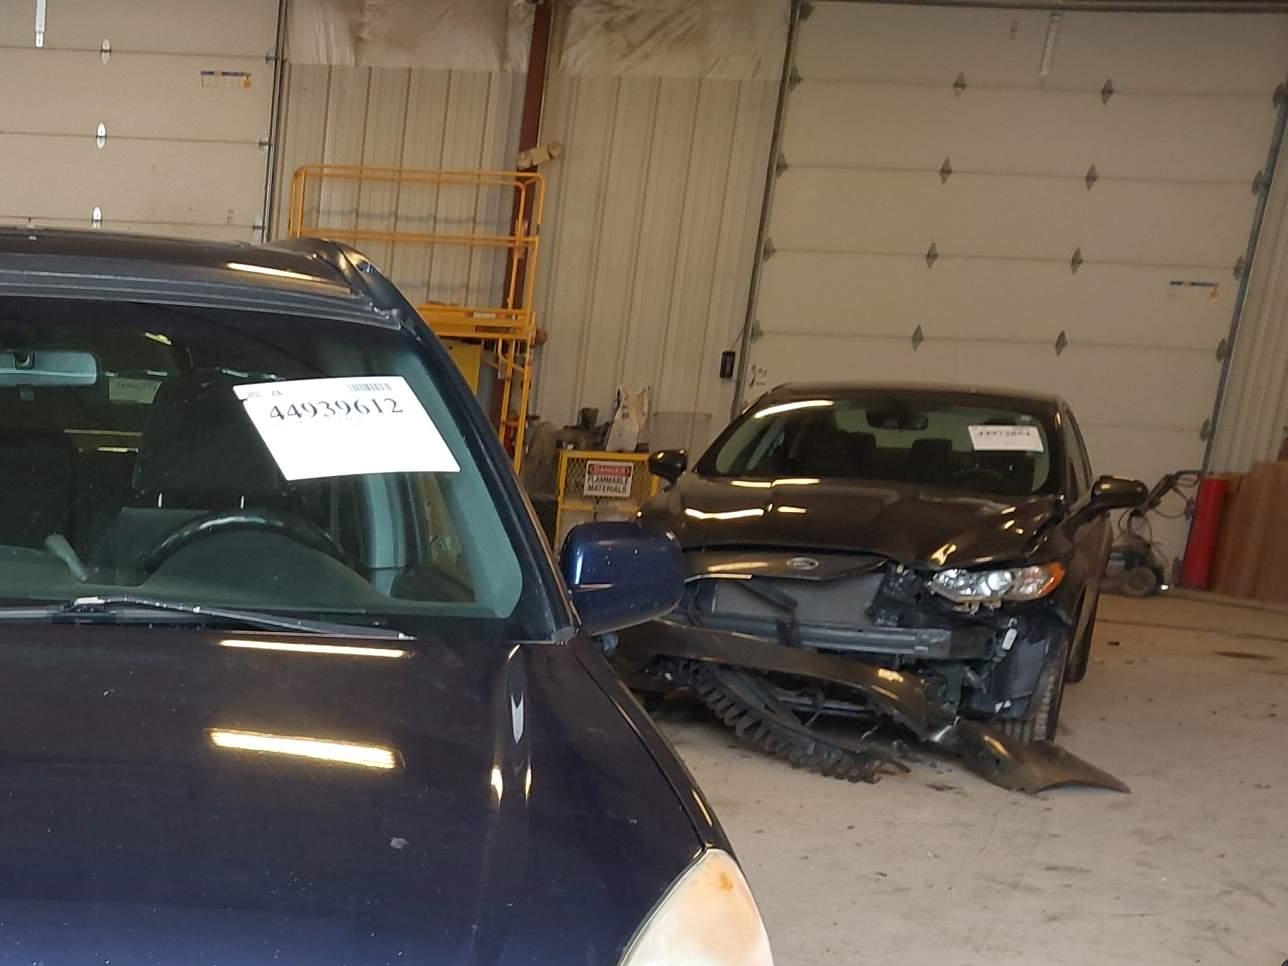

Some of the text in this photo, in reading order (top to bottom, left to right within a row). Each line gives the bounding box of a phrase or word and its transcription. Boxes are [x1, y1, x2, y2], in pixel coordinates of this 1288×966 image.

[269, 398, 404, 420] 44939612
[594, 465, 627, 476] DANGER
[587, 475, 629, 485] FLAMMABLE
[587, 484, 627, 494] MATERIALS
